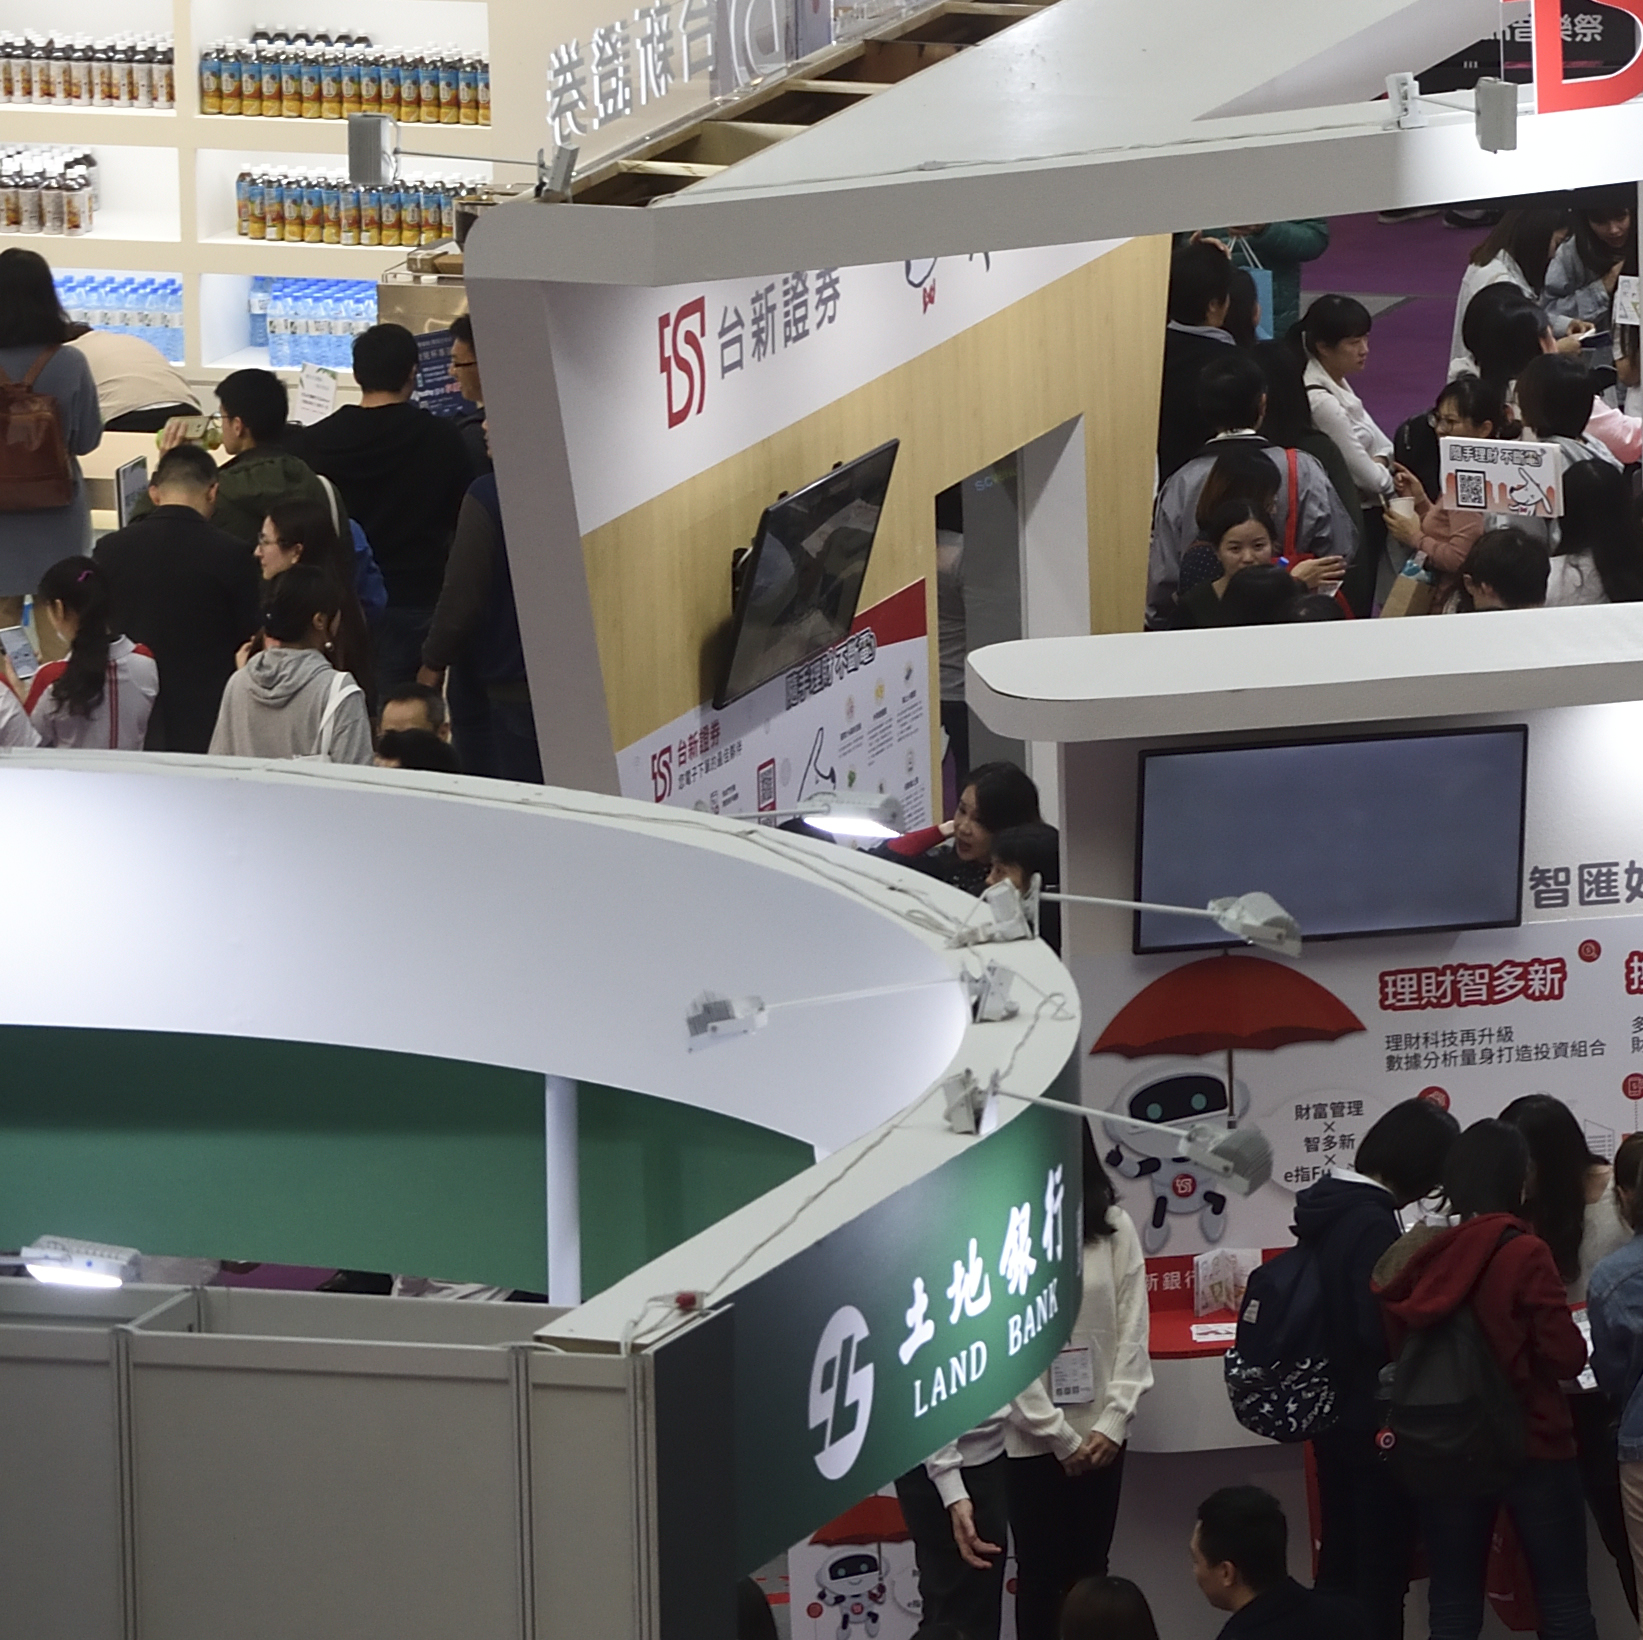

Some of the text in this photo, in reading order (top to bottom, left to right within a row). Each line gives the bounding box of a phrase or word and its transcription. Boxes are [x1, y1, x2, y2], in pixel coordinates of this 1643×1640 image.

[717, 266, 841, 380] 台新證券
[1380, 960, 1565, 1011] 理財智多新
[1383, 1027, 1515, 1053] 理財科技再升級
[1384, 1037, 1607, 1073] 數據分析量身打造投資組合
[1294, 1100, 1365, 1122] 財富管理
[1303, 1133, 1356, 1153] 智多新
[898, 1162, 1067, 1366] 土地銀行
[913, 1276, 1060, 1419] LAND BANK
